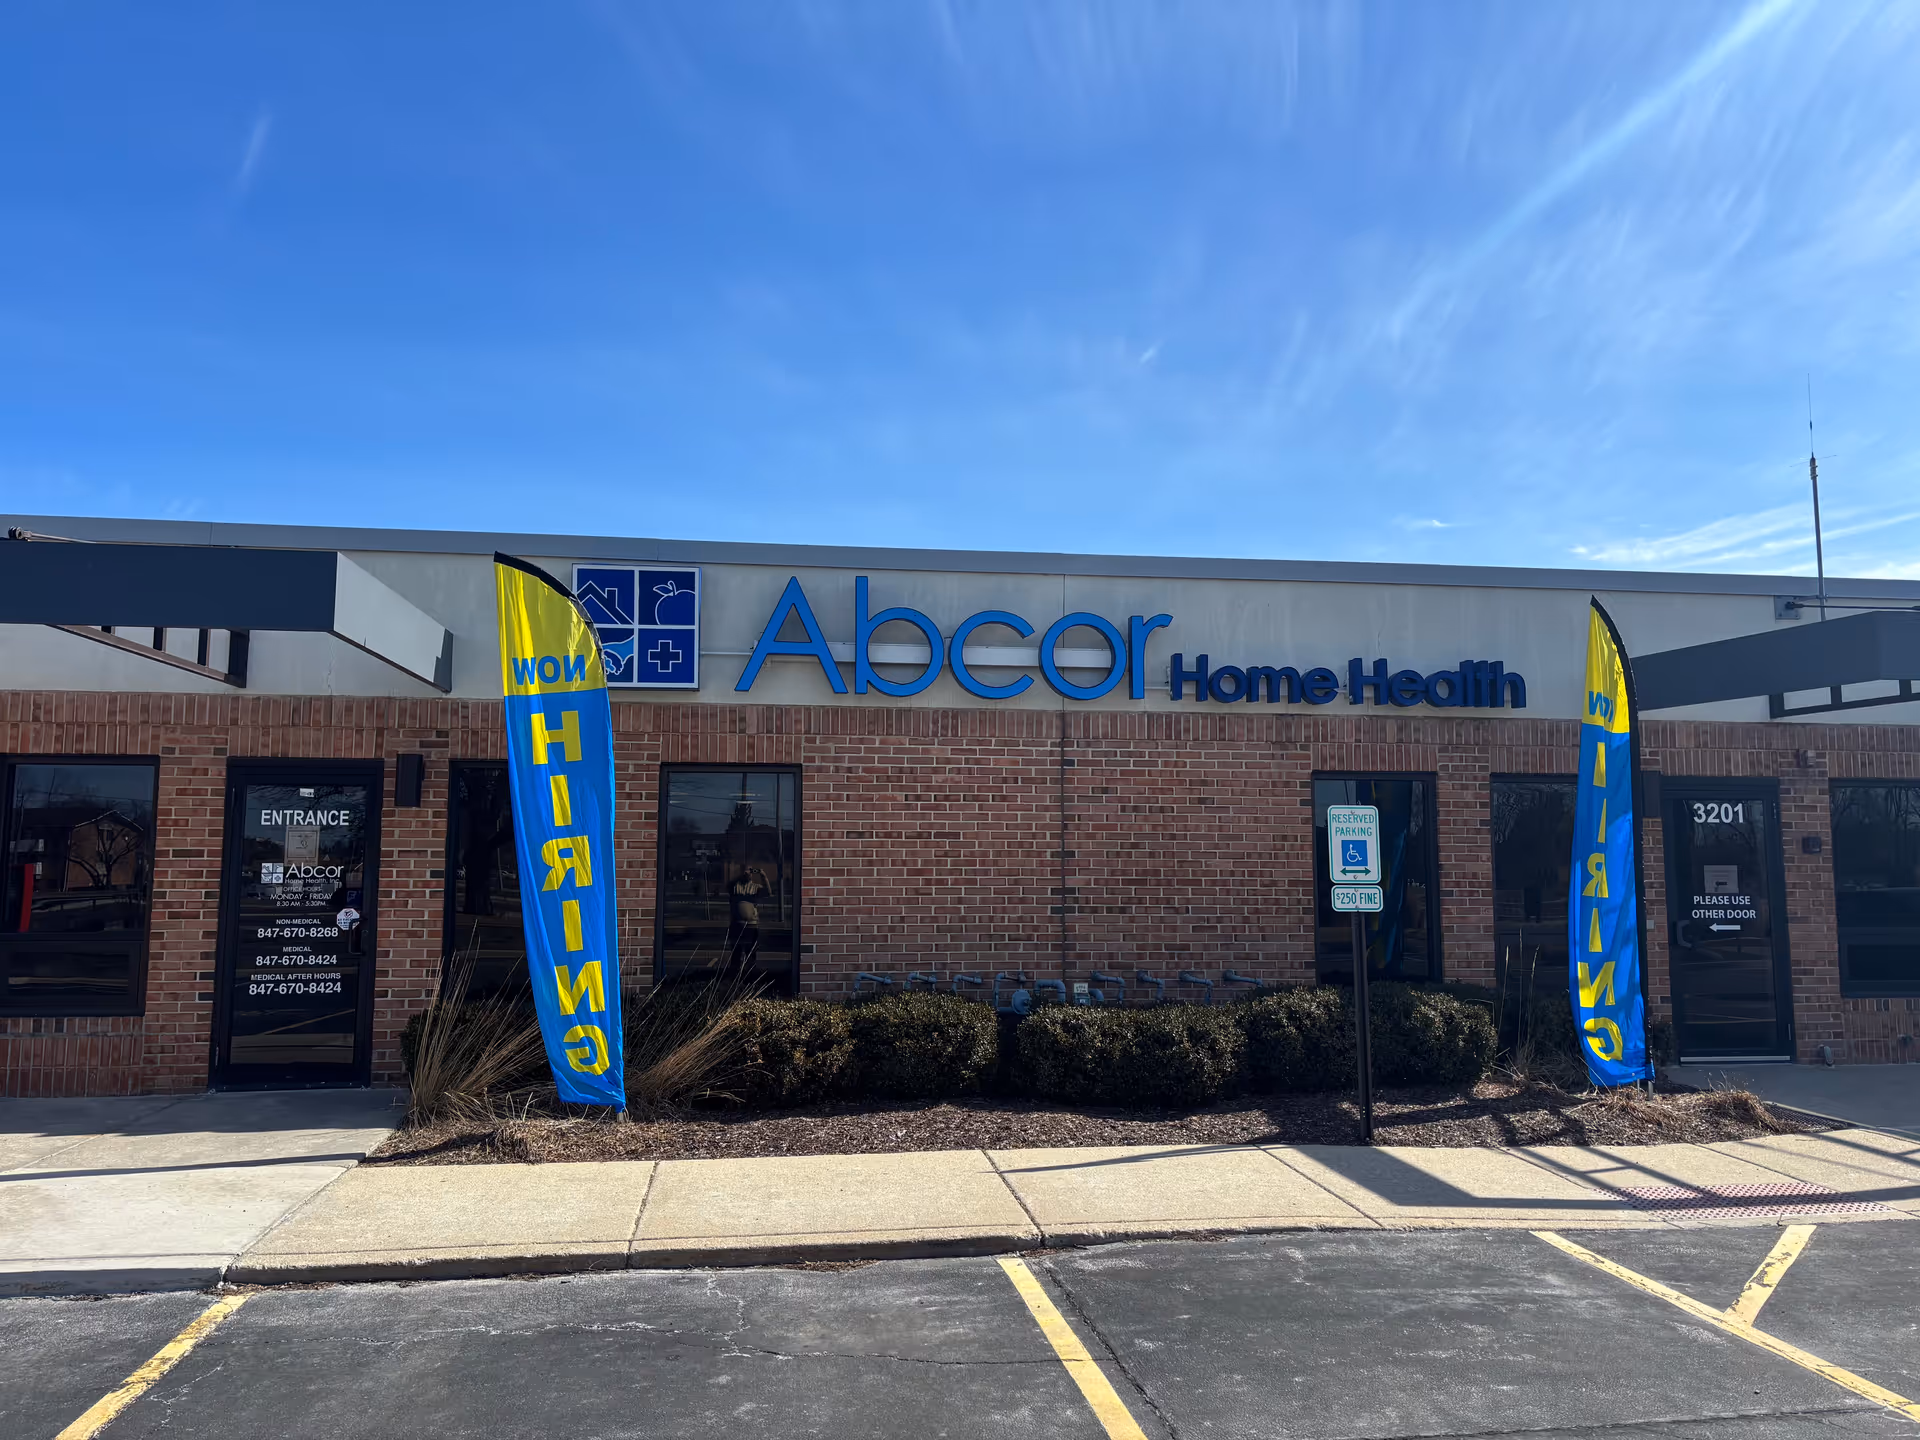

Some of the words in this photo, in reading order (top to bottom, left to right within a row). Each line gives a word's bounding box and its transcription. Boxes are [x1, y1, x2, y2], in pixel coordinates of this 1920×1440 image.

[734, 576, 1173, 700] Abcor
[1170, 653, 1339, 706] Home
[1348, 657, 1527, 708] Health
[260, 809, 350, 826] ENTRANCE
[1332, 813, 1375, 824] RESERVED
[1692, 803, 1744, 824] 3201
[1335, 826, 1373, 837] PARKING
[285, 862, 345, 878] Abcor
[1336, 892, 1357, 905] $250
[1359, 892, 1378, 905] FINE
[1693, 895, 1730, 905] PLEASE
[1731, 895, 1751, 905] USE
[1692, 909, 1725, 919] OTHER
[1727, 909, 1757, 919] DOOR
[257, 927, 339, 938] 847-670-8268
[255, 954, 337, 966] 847-670-8424
[251, 973, 285, 981] MEDICAL
[286, 972, 313, 980] AFTER
[313, 972, 341, 980] HOURS
[249, 981, 342, 995] 847-670-8424
